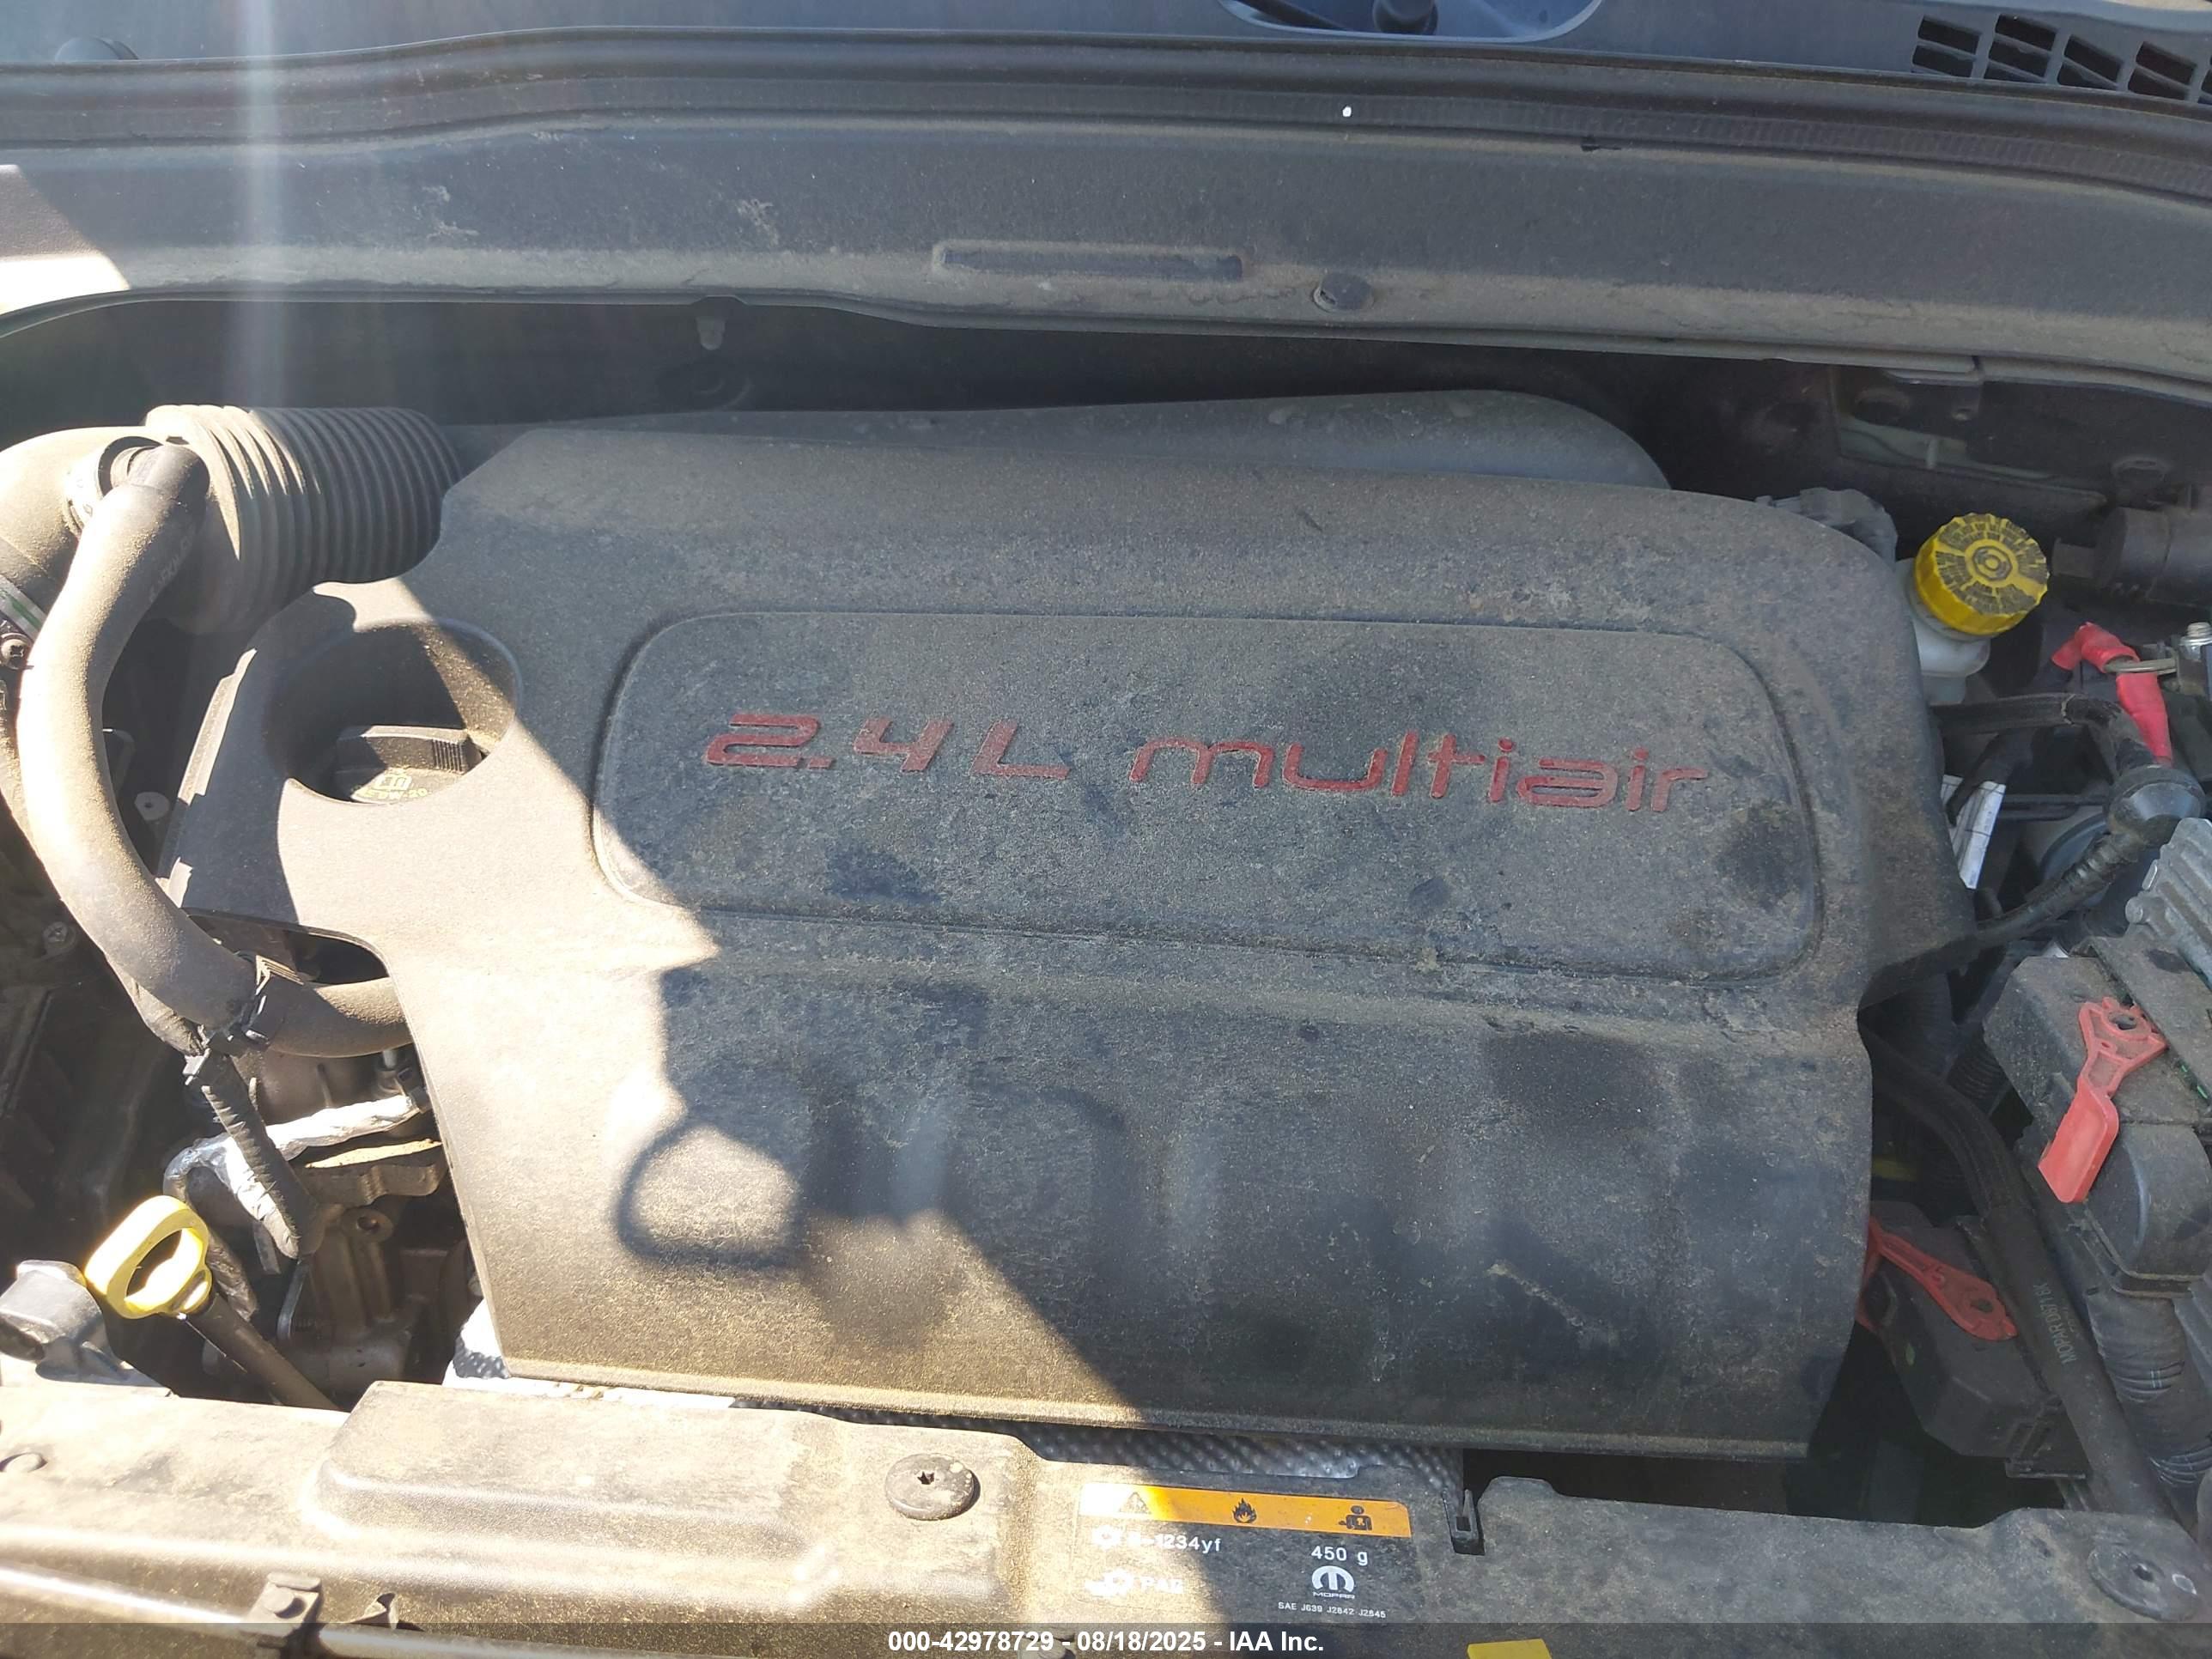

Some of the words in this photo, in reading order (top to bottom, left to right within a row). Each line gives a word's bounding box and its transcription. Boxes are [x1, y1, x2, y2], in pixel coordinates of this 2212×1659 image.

[1127, 731, 1710, 811] multiair
[2047, 1322, 2076, 1364] MOPAR
[1310, 1545, 1348, 1562] 450
[1357, 1551, 1369, 1566] g
[1312, 1590, 1356, 1601] MOPAR
[1277, 1601, 1297, 1612] SAE
[1301, 1603, 1323, 1613] J639
